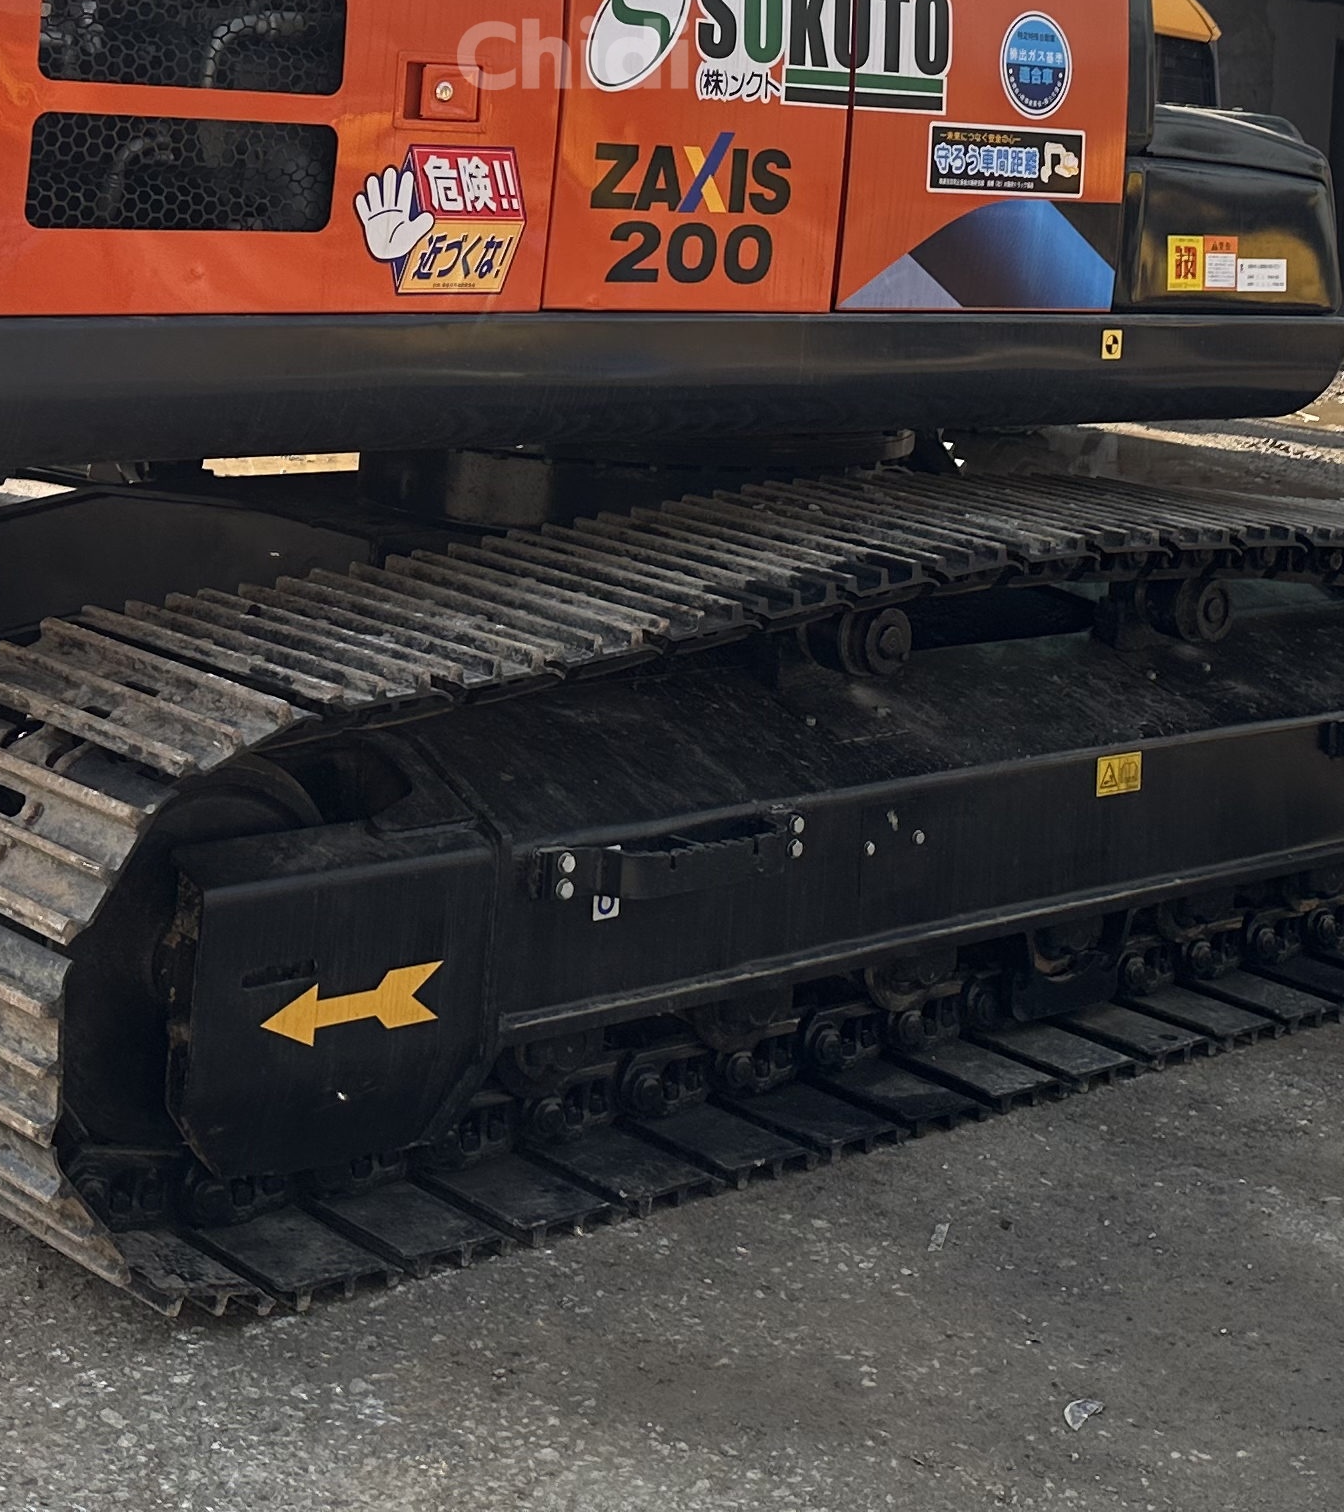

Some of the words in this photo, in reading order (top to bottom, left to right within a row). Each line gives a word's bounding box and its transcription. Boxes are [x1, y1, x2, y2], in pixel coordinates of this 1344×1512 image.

[589, 131, 793, 215] ZAXIS
[934, 142, 1040, 179] 守ろう車間距離
[603, 220, 774, 285] 200
